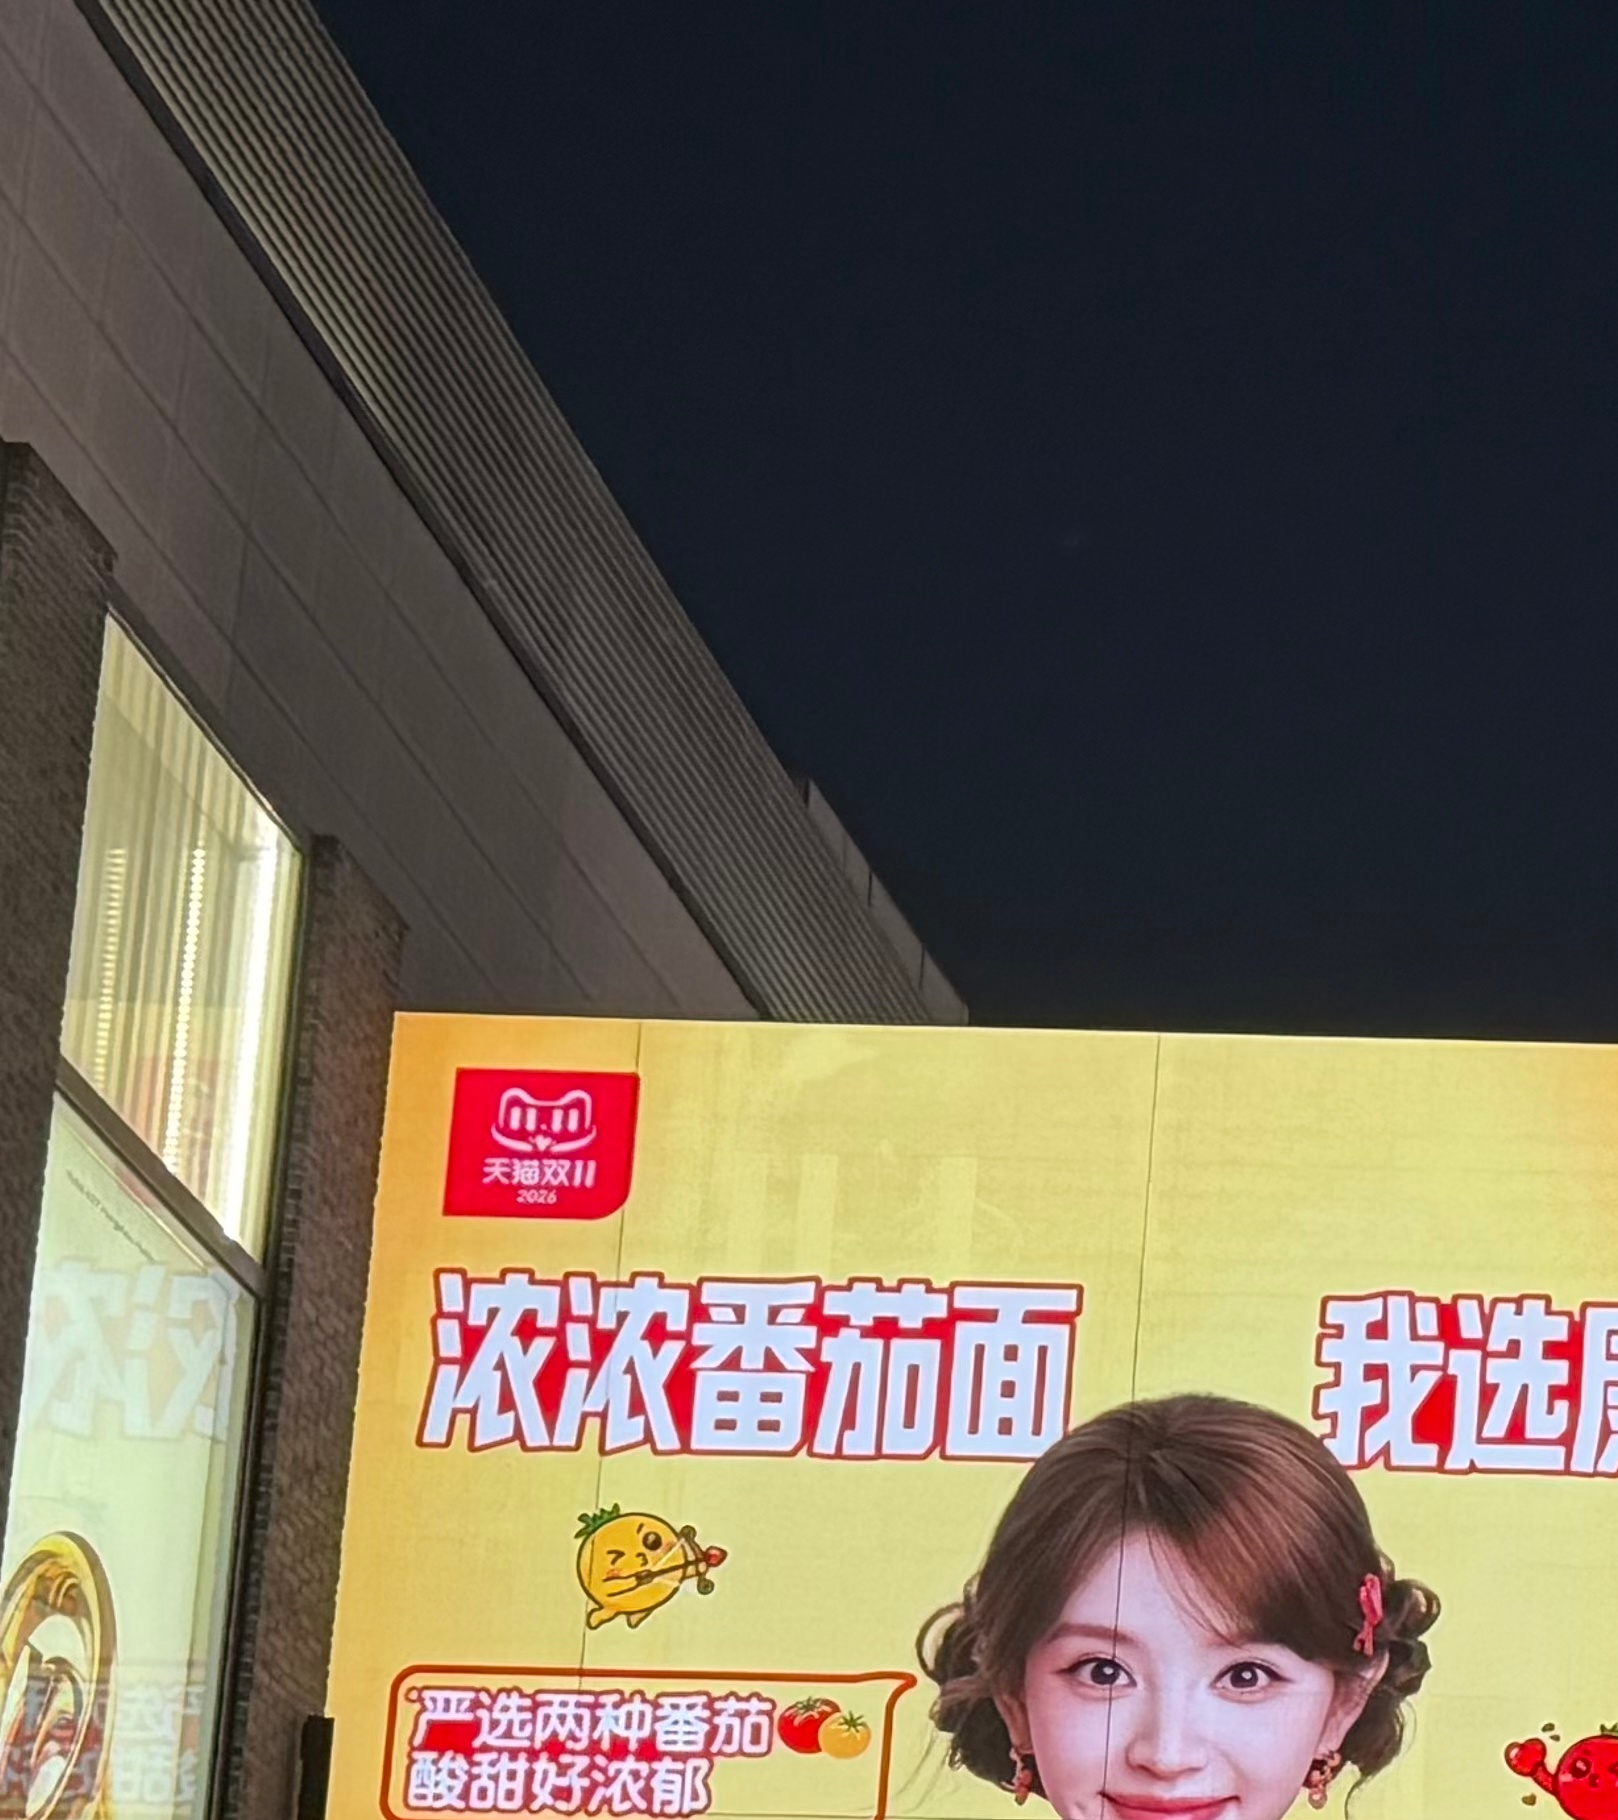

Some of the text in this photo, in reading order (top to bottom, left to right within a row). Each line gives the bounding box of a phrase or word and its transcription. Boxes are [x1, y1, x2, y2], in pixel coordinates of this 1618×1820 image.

[482, 1157, 597, 1188] 天猫双11
[418, 1268, 1083, 1462] 浓浓番茄面
[411, 1687, 776, 1757] 严选两种番茄
[407, 1751, 713, 1816] 酸甜好浓郁
